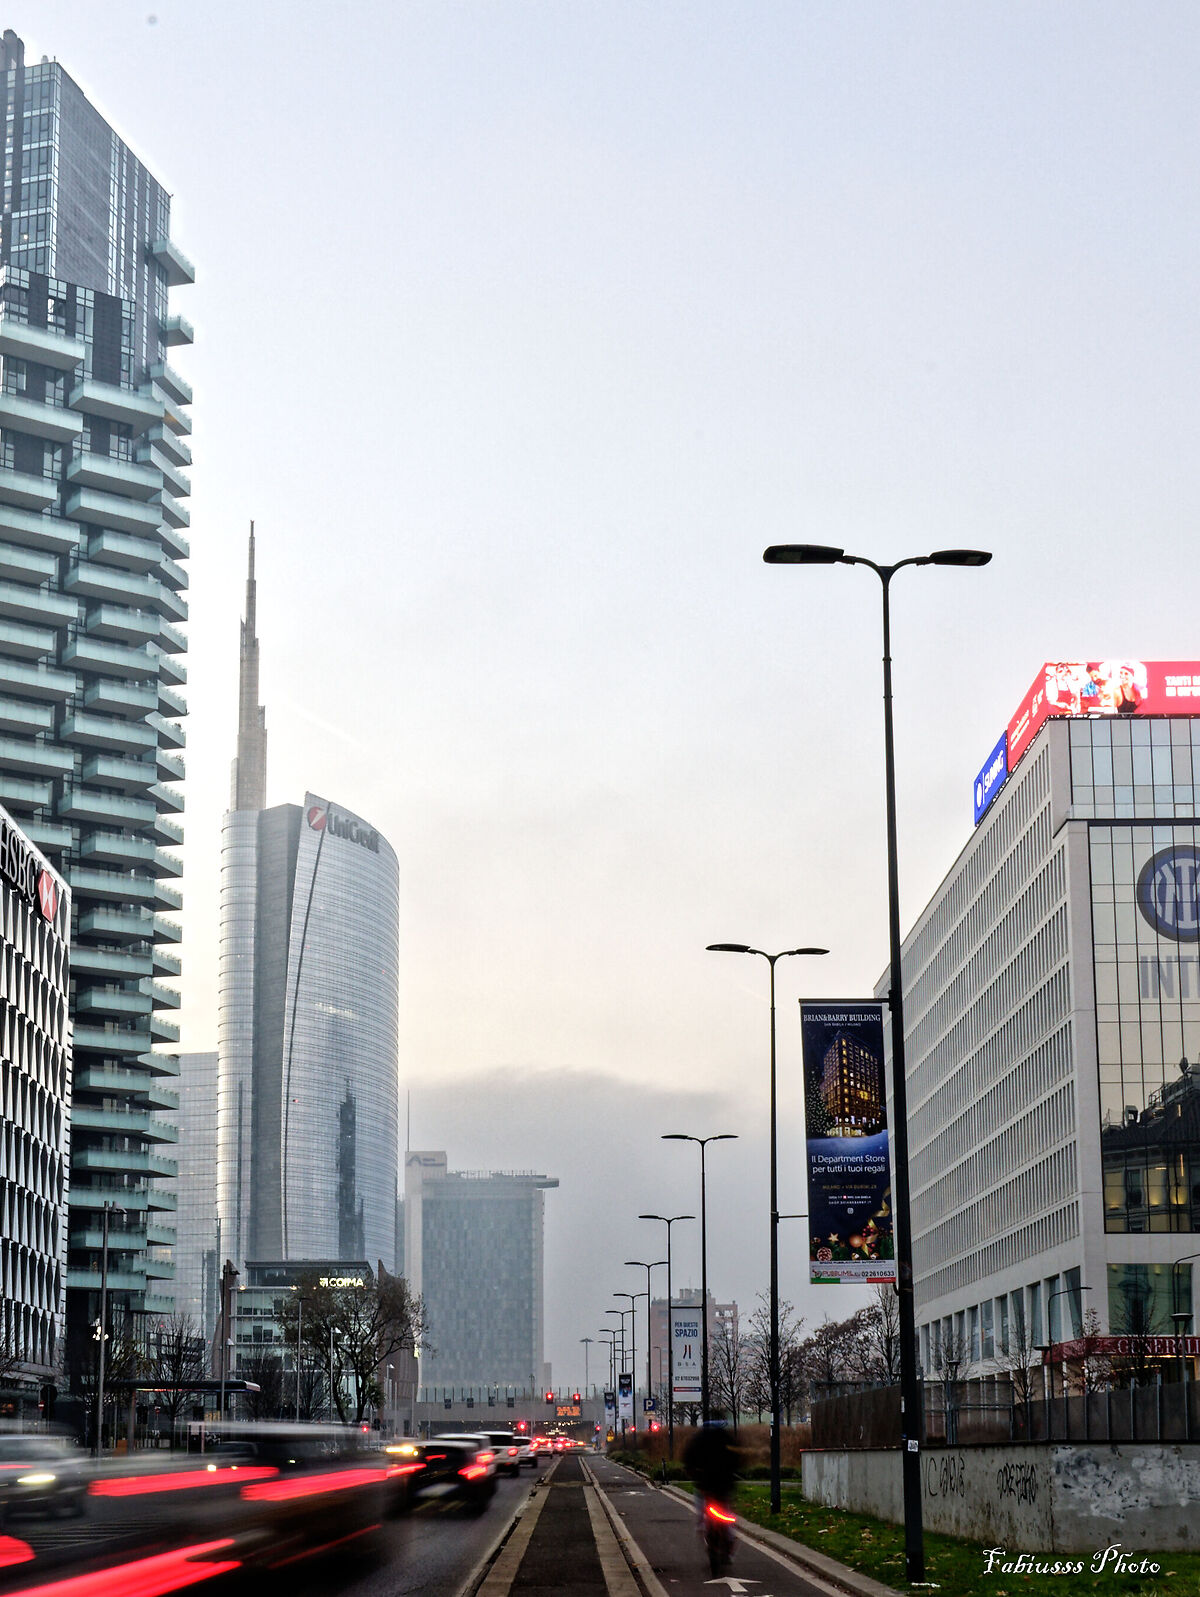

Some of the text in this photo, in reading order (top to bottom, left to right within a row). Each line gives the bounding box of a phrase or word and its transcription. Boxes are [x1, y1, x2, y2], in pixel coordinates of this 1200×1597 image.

[849, 1014, 881, 1022] BUILDING
[817, 1155, 864, 1164] Department
[865, 1154, 886, 1163] Store
[827, 1165, 843, 1173] tutti
[847, 1165, 863, 1173] tuoi
[864, 1165, 886, 1174] regali
[674, 1328, 698, 1338] SPAZIO
[646, 1400, 654, 1410] P
